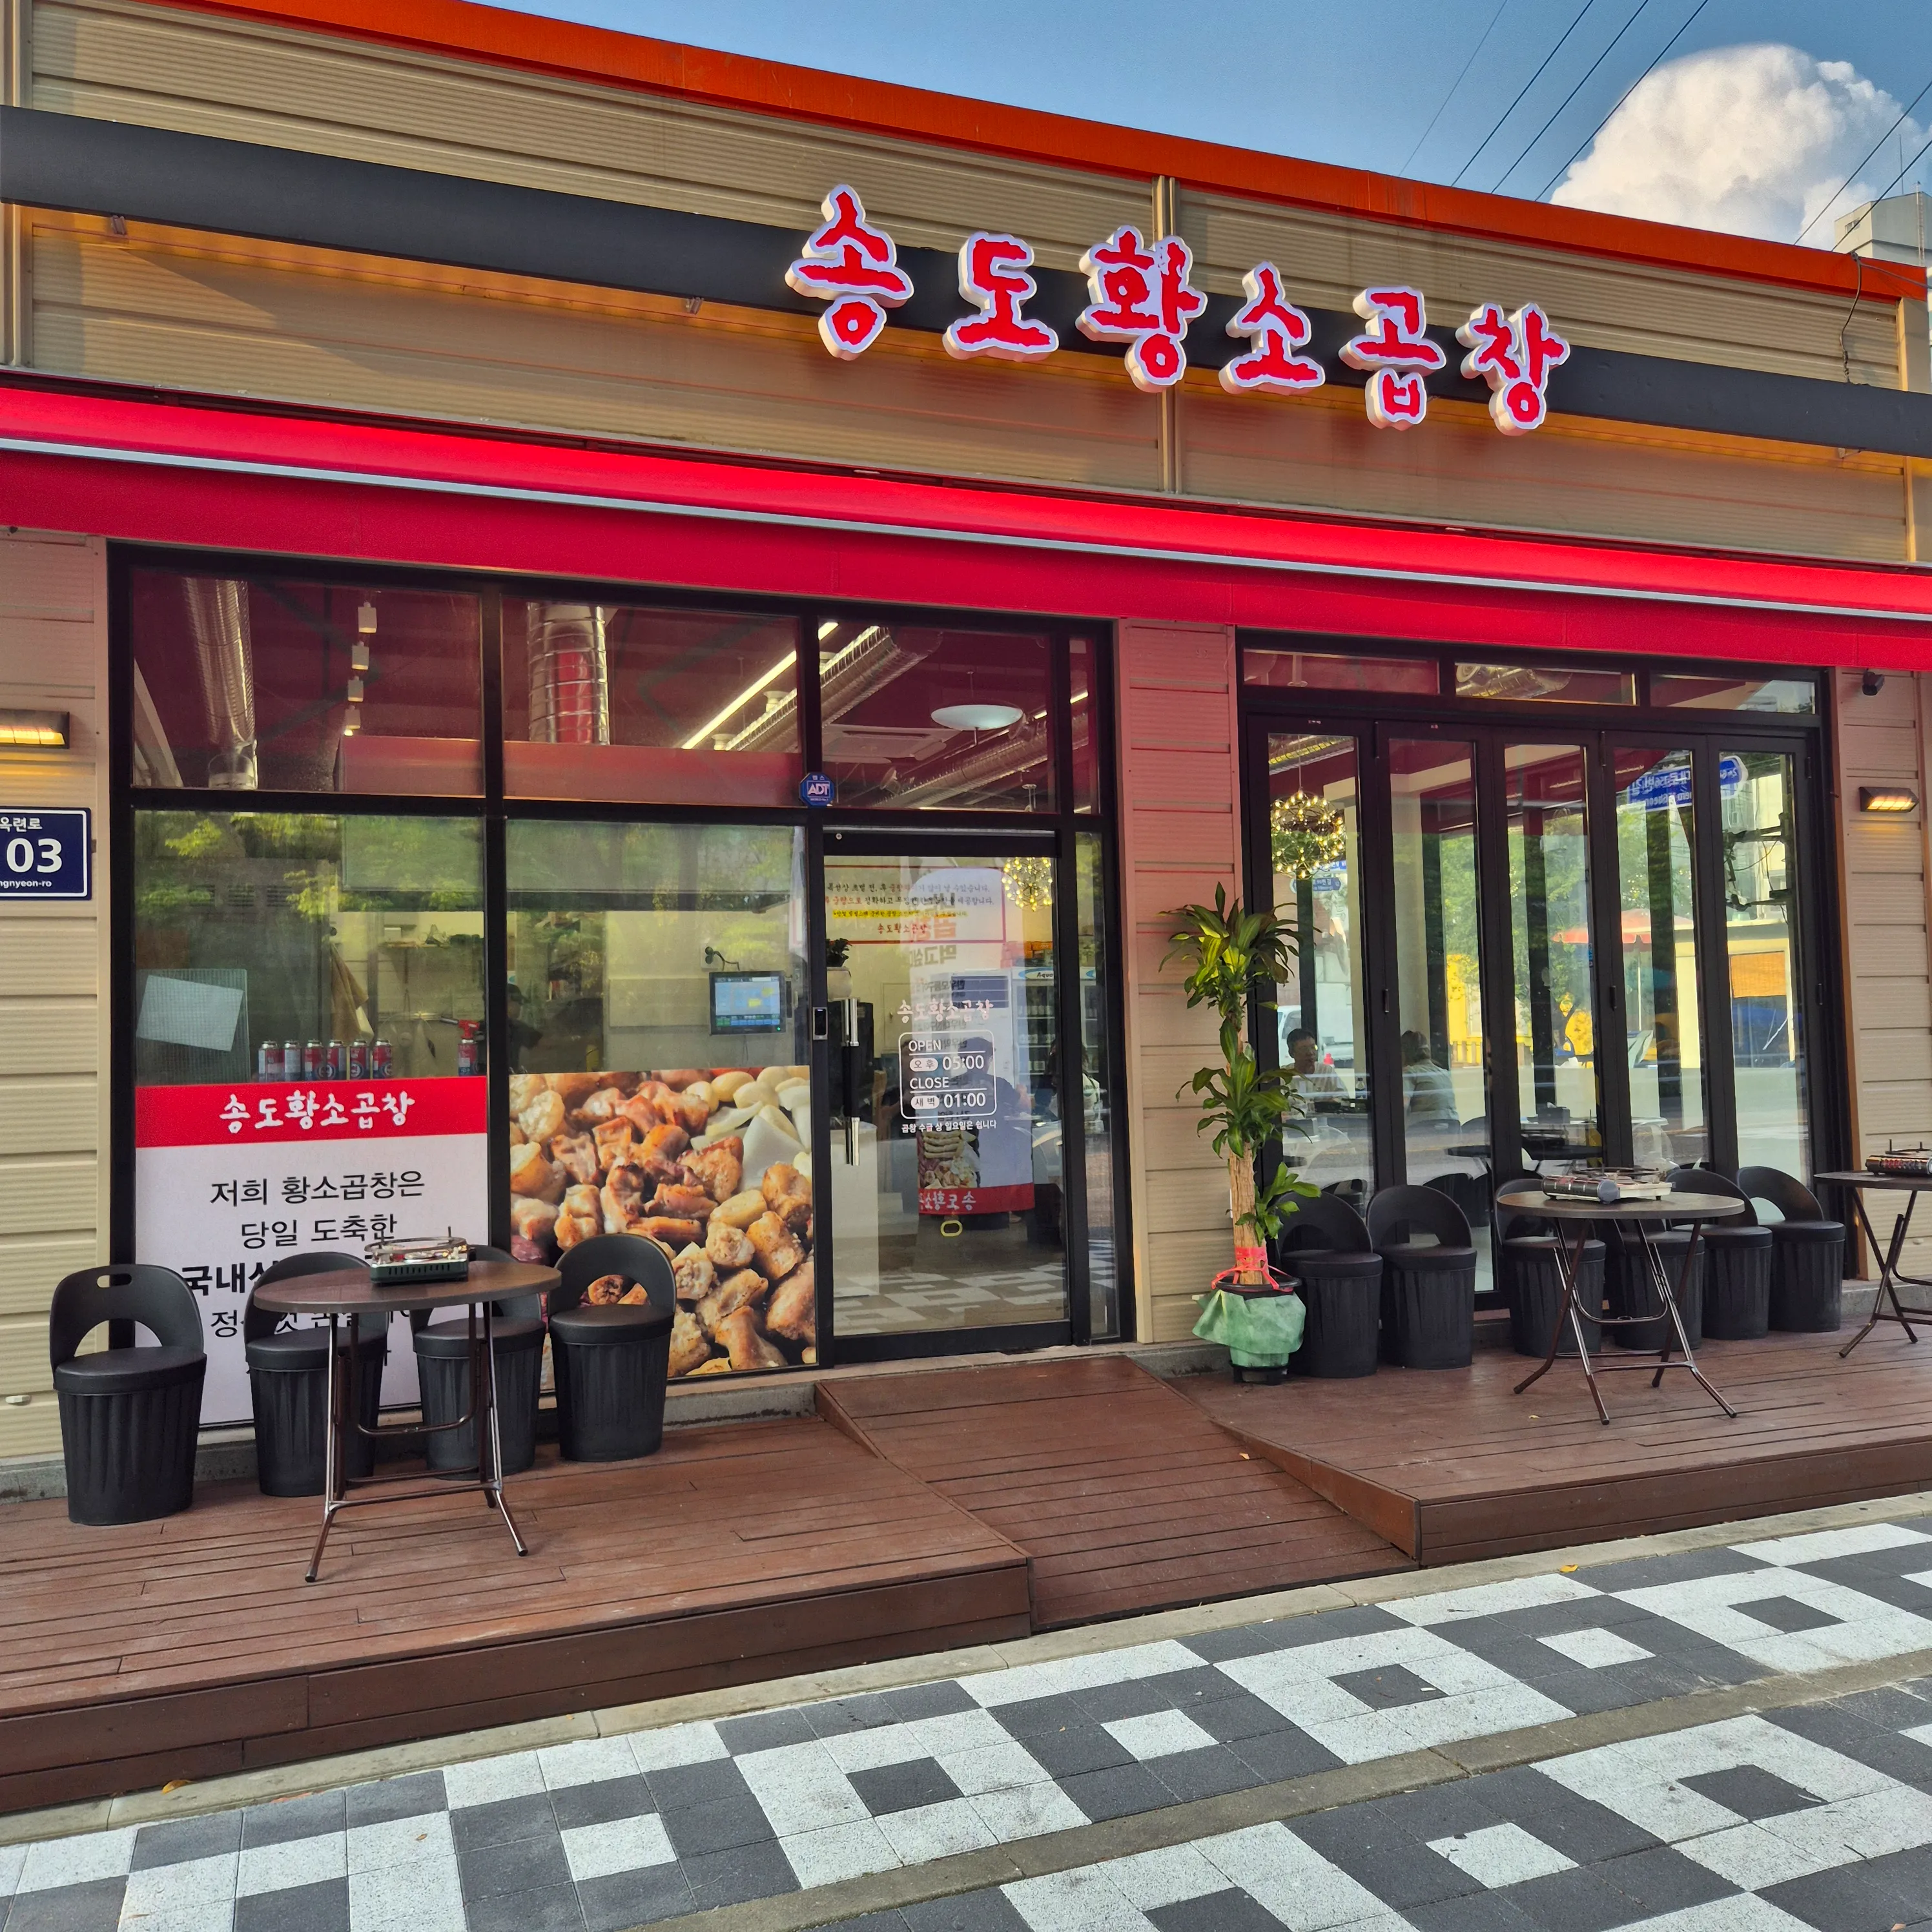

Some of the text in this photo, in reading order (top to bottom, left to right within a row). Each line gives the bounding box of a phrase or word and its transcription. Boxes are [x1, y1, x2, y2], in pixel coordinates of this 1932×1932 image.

[785, 185, 1570, 434] 송도황소곱창
[808, 783, 830, 795] ADT
[0, 817, 43, 832] 옥련로
[897, 998, 994, 1023] 송도황소곱창
[909, 1040, 941, 1052] OPEN
[942, 1054, 984, 1071] 05:00
[909, 1076, 949, 1089] CLOSE
[943, 1093, 986, 1108] 01:00
[219, 1089, 415, 1134] 송도황소곱창
[901, 1120, 997, 1133] 곱창 수급 상 일요일은 쉽니다
[210, 1170, 426, 1207] 저희 황소곱창은
[241, 1213, 398, 1250] 당일 도축한
